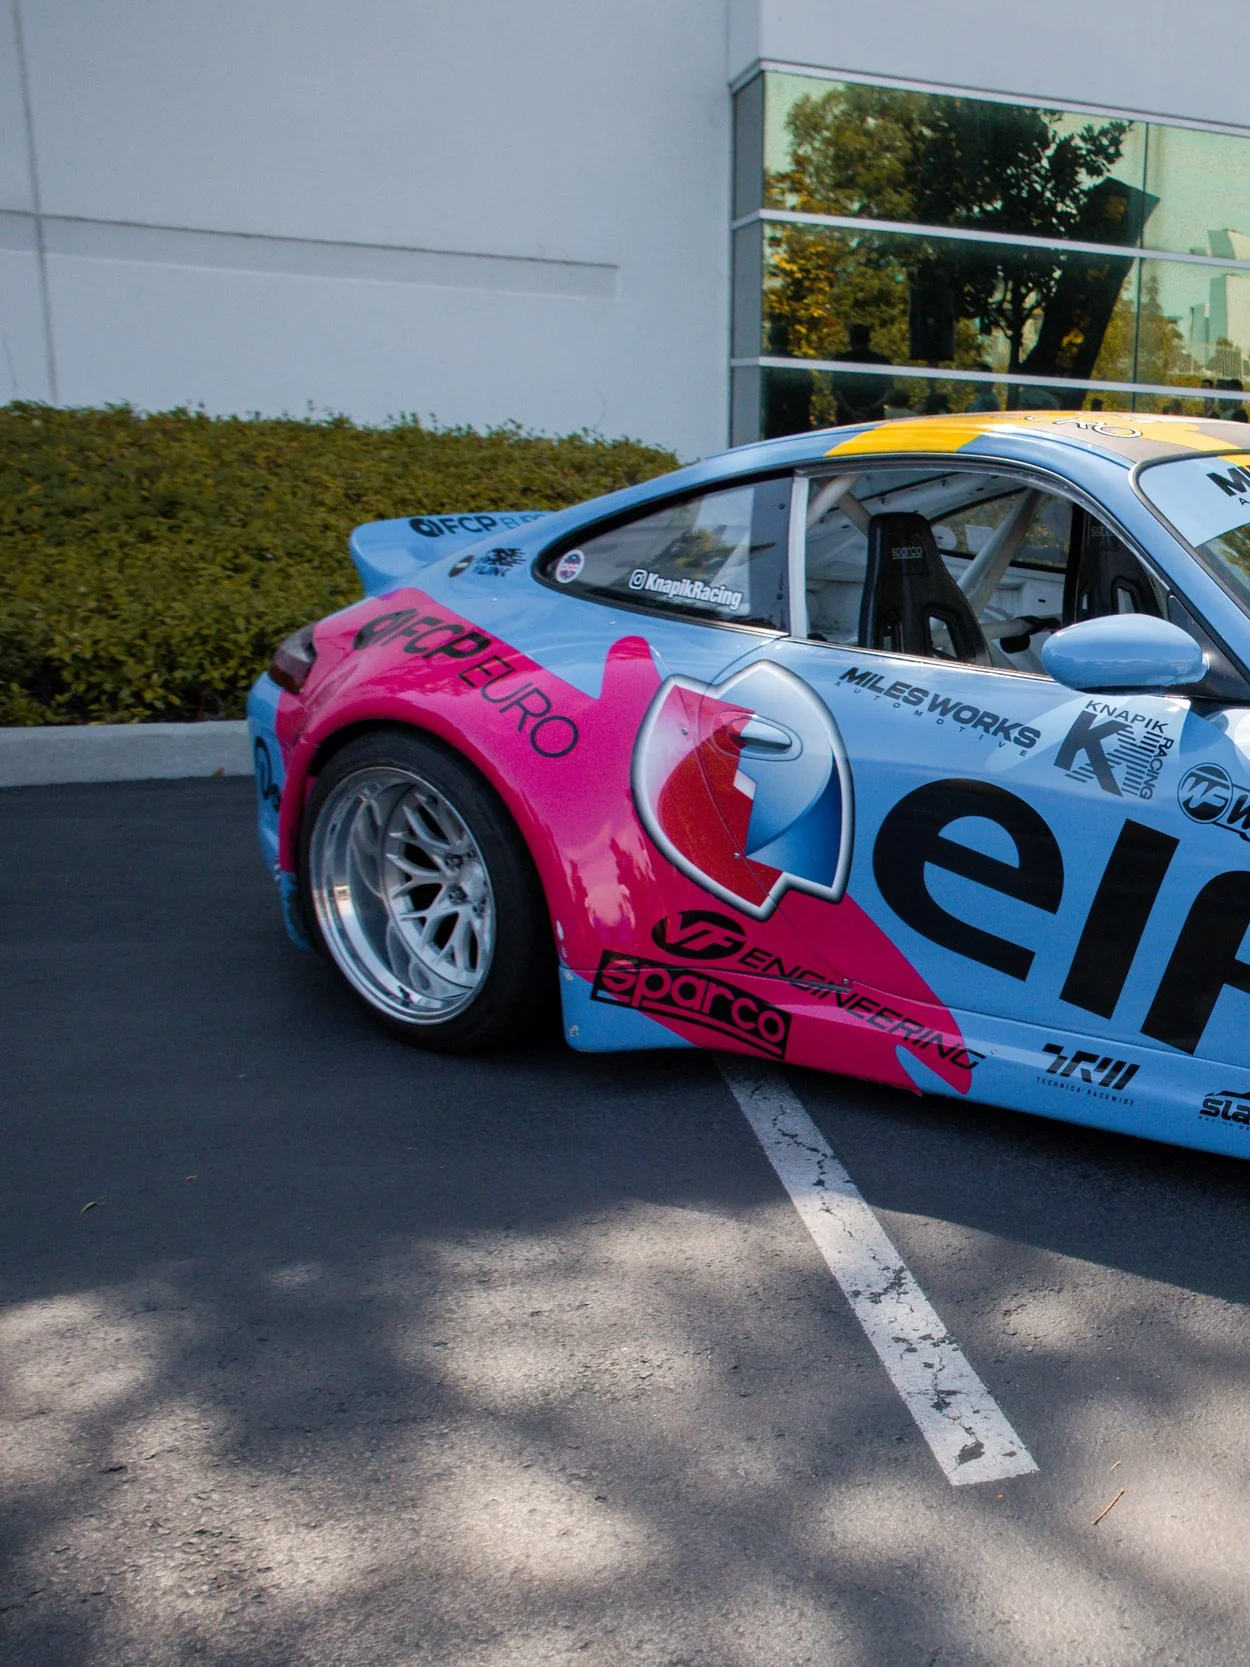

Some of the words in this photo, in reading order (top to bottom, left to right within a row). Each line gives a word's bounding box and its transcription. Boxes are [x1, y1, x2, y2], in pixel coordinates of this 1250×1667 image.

[438, 515, 498, 535] FCP
[645, 572, 743, 611] KnapikRacing
[380, 615, 492, 660] FCP
[457, 655, 580, 759] EURO
[833, 681, 1028, 757] AUTOMOTIVE
[1084, 700, 1169, 734] KNAPIK
[1139, 736, 1176, 801] RACING
[600, 957, 788, 1046] sparco
[738, 946, 987, 1071] ENGINEERING
